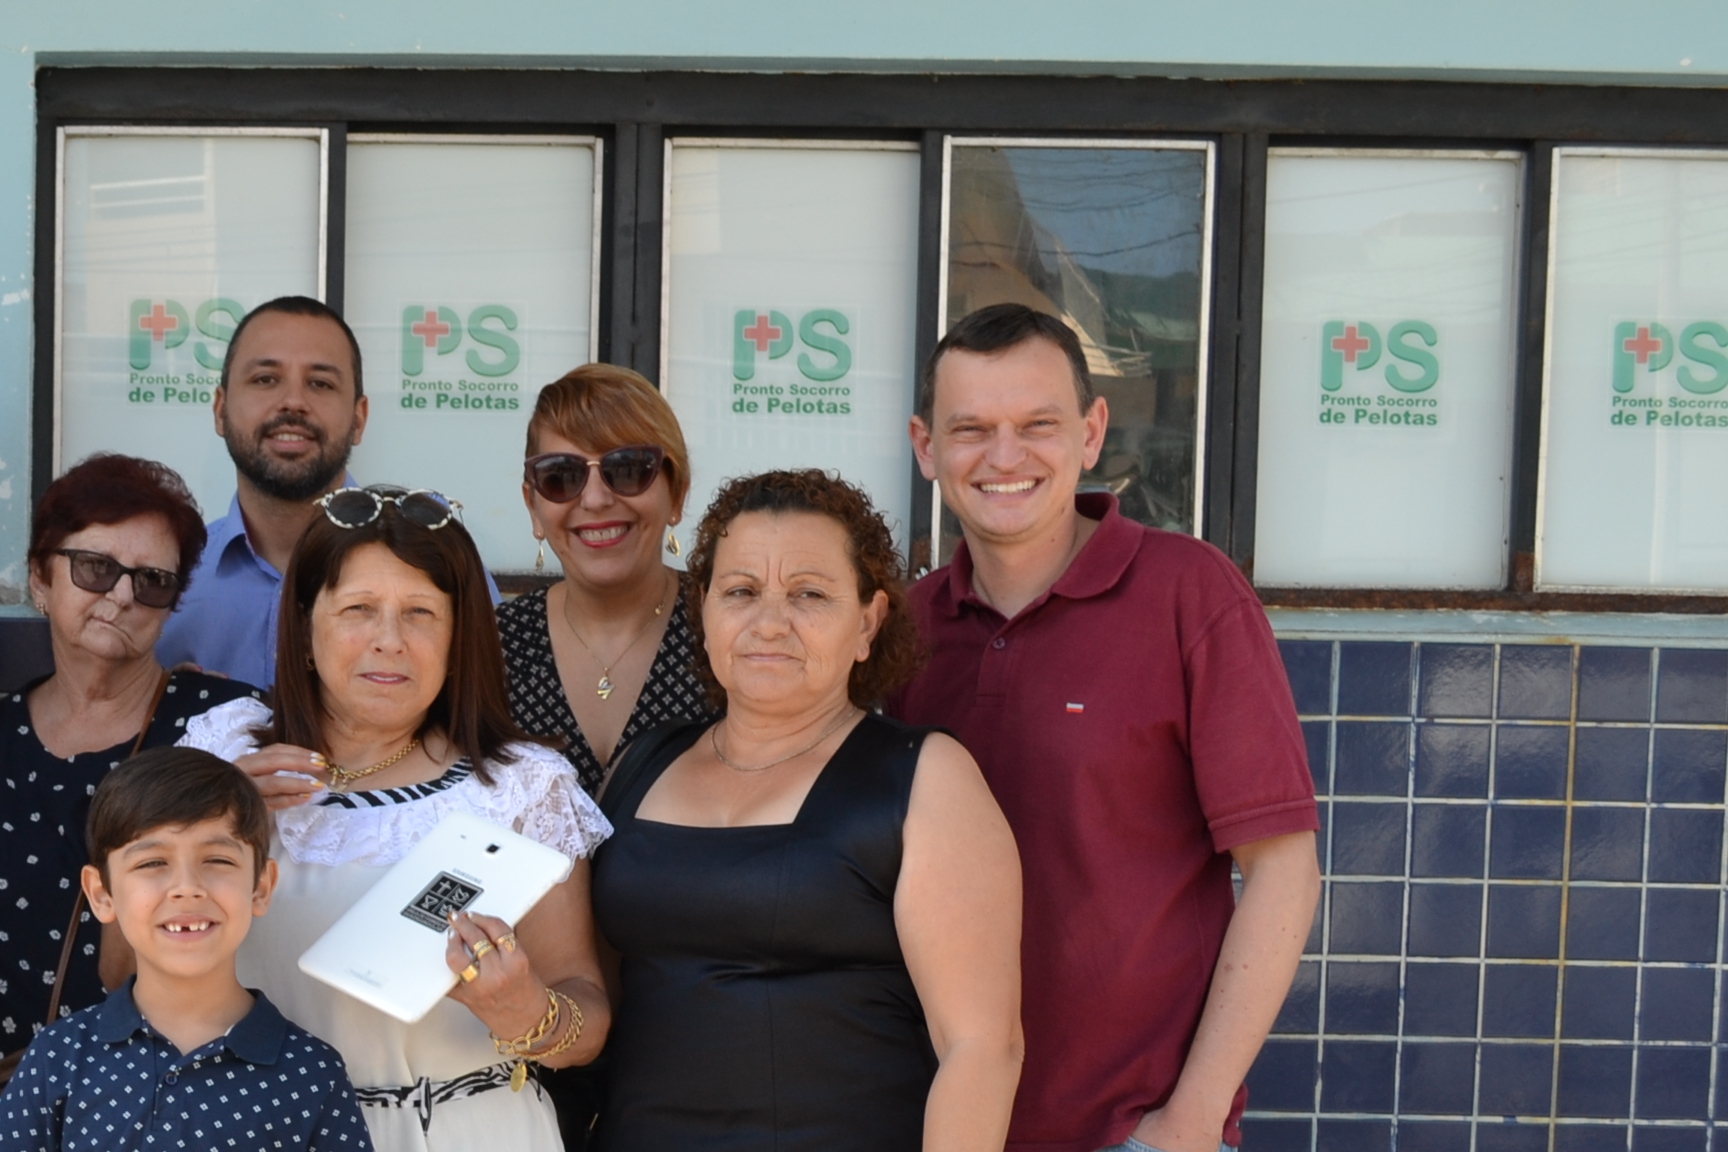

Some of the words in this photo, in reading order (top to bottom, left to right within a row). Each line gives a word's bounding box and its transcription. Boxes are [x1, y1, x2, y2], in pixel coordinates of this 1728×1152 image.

[401, 304, 521, 378] PS
[733, 308, 852, 382] PS
[1320, 319, 1440, 394] PS
[1612, 320, 1728, 395] PS
[129, 373, 180, 386] Pronto
[401, 379, 453, 391] Pronto
[458, 379, 520, 392] Socorro
[128, 387, 155, 403] de
[163, 387, 212, 404] Pelo
[733, 383, 784, 396] Pronto
[789, 383, 851, 397] Socorro
[400, 393, 428, 409] de
[435, 393, 520, 410] Pelotas
[731, 397, 759, 413] de
[767, 397, 852, 415] Pelotas
[1320, 394, 1372, 406] Pronto
[1376, 394, 1438, 408] Socorro
[1612, 396, 1664, 408] Pronto
[1668, 396, 1728, 410] Socorro
[1318, 408, 1346, 424] de
[1353, 408, 1438, 426] Pelotas
[1610, 410, 1638, 426] de
[1645, 410, 1728, 428] Pelotas
